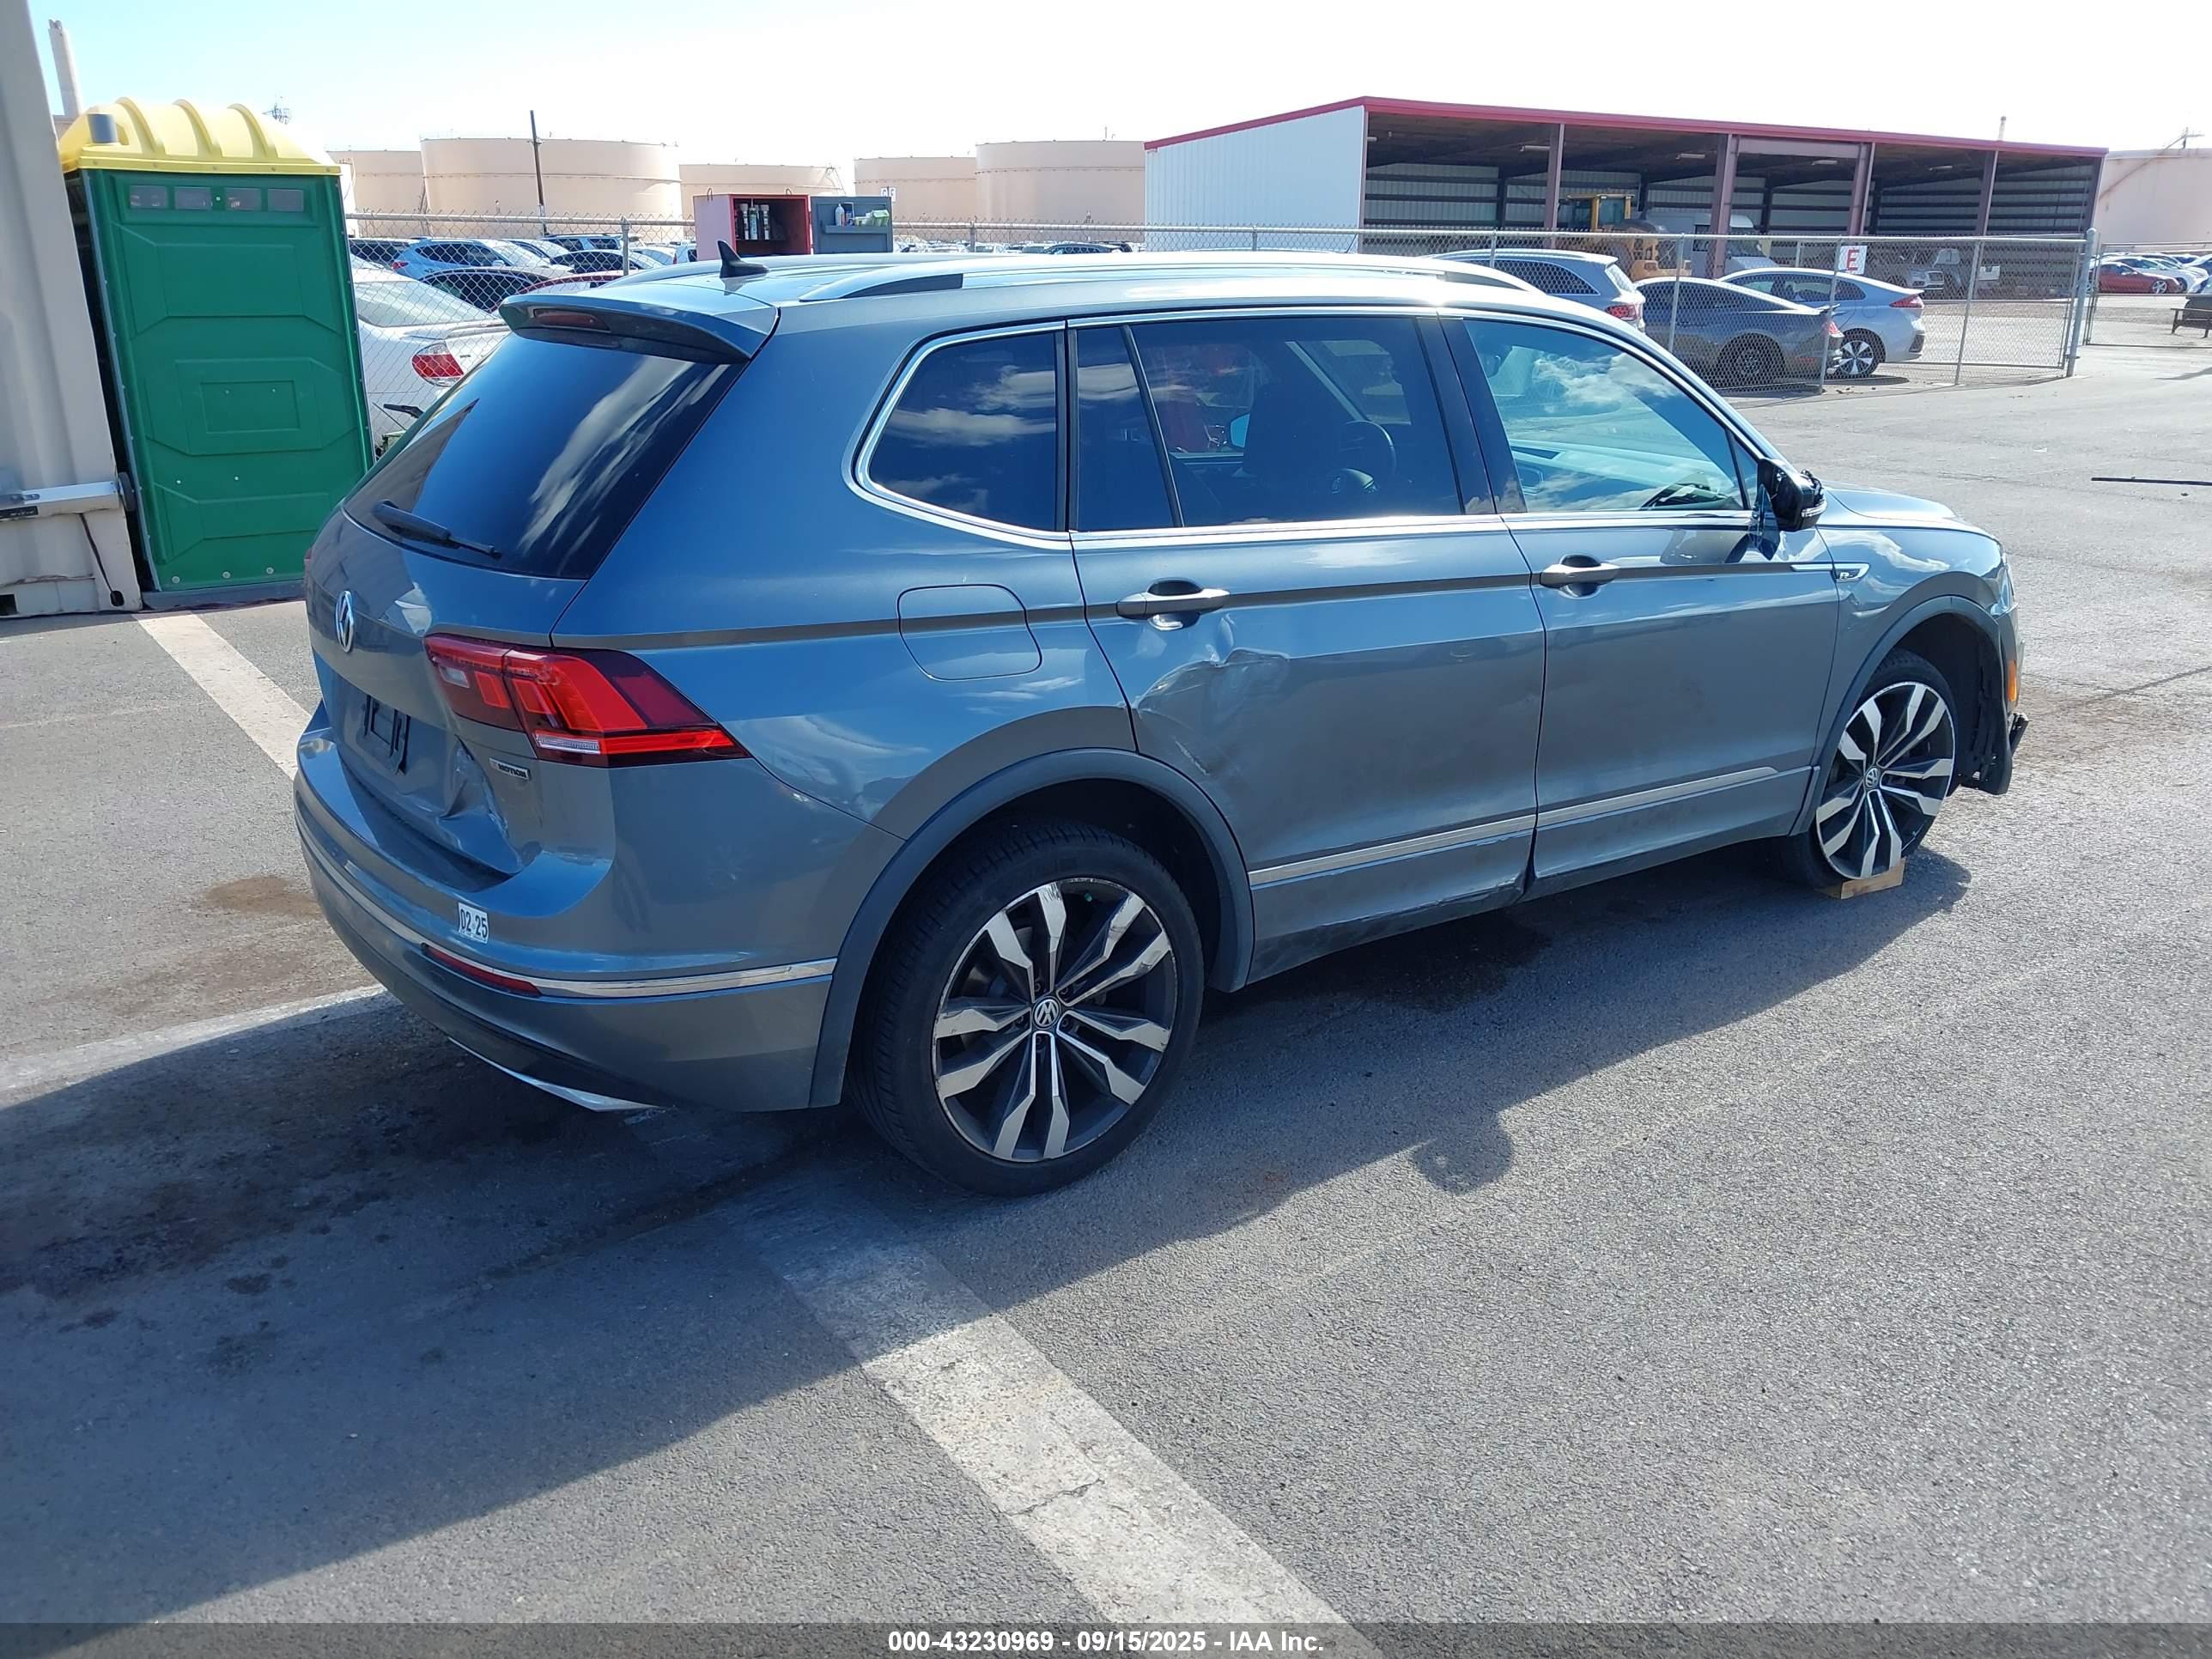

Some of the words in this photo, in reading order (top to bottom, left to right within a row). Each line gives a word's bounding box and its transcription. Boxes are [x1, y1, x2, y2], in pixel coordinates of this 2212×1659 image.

[1846, 249, 1860, 271] E
[460, 908, 471, 932] 02
[475, 915, 488, 939] 25
